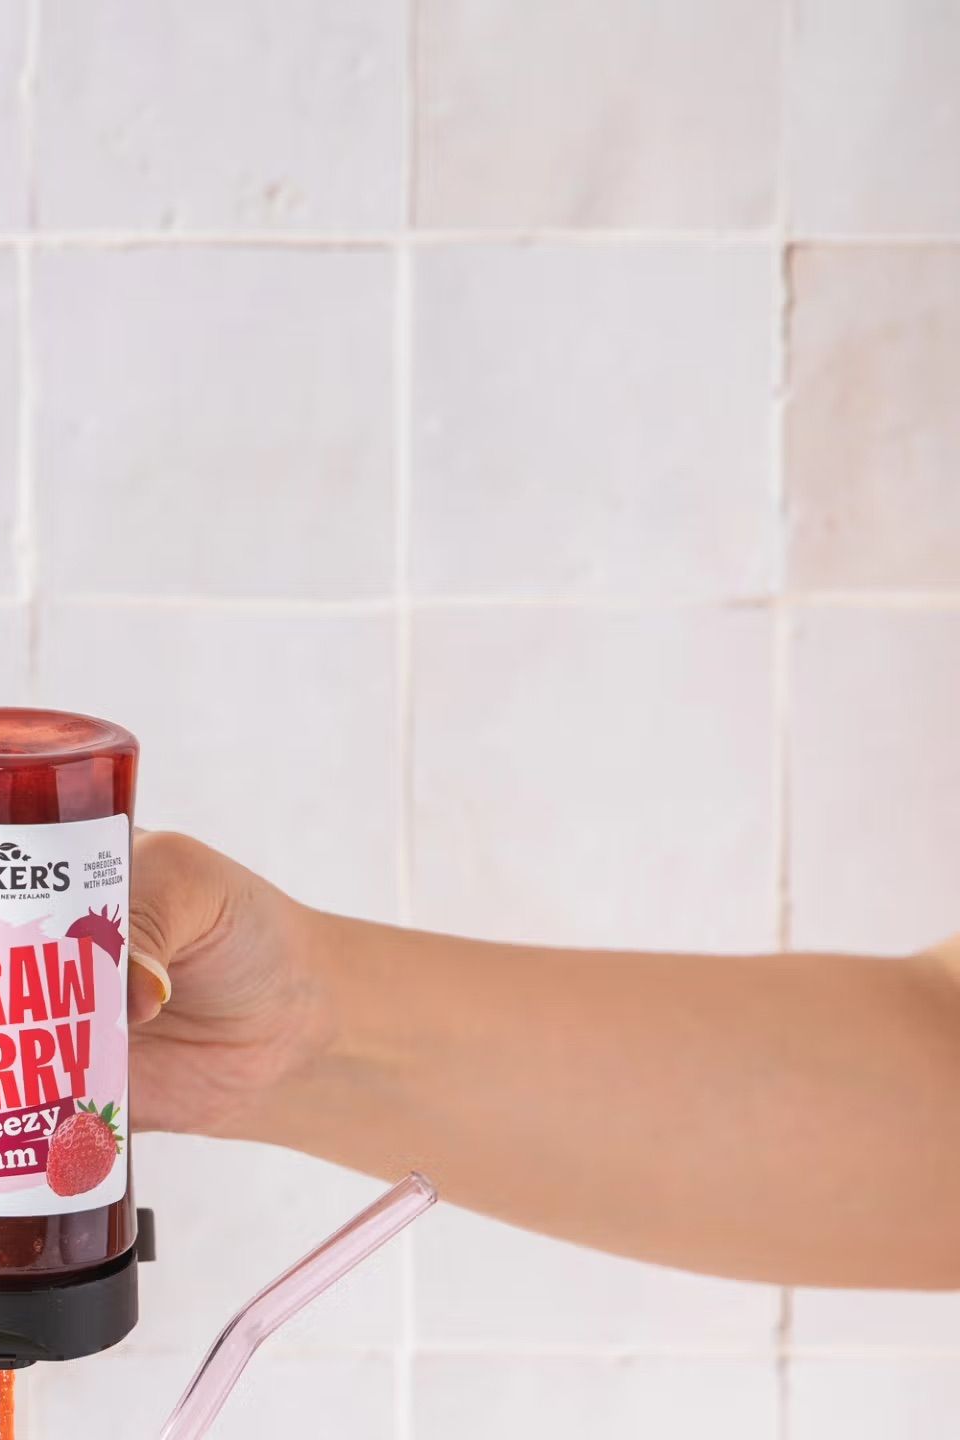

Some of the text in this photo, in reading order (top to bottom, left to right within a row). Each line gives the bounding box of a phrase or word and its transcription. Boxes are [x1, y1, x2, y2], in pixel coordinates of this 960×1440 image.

[98, 850, 112, 860] REAL
[92, 867, 117, 879] CRAFTED
[83, 875, 123, 889] WITH PASSION
[18, 892, 51, 900] ZEALAND
